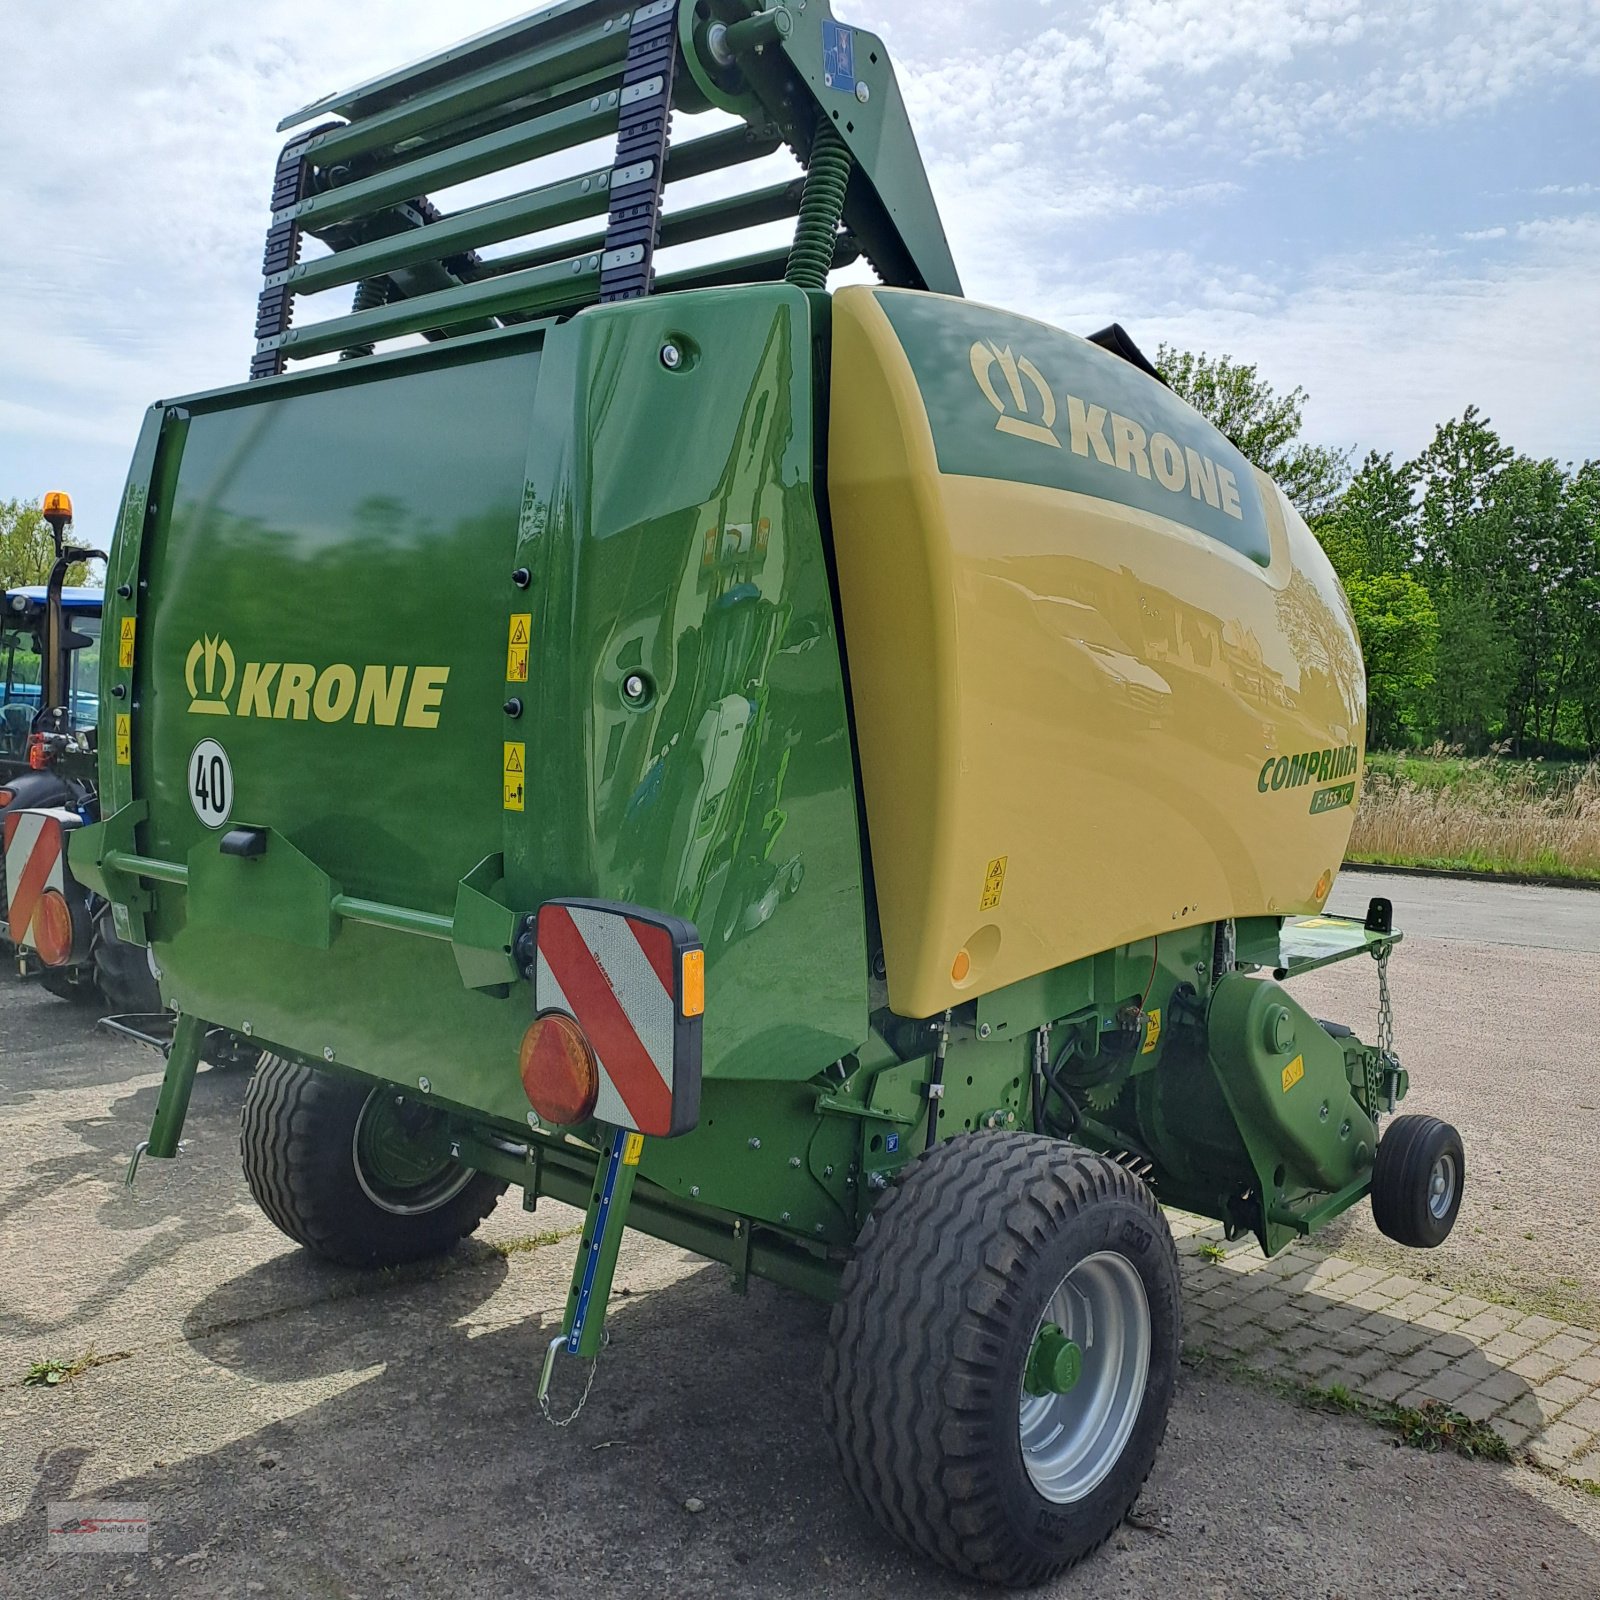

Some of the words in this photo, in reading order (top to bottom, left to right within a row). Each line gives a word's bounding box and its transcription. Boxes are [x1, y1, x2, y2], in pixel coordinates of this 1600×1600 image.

[1066, 394, 1243, 521] KRONE
[236, 662, 451, 729] KRONE
[195, 754, 226, 813] 40
[1258, 745, 1357, 793] COMPRIMA
[1315, 794, 1324, 810] F
[1324, 790, 1339, 808] 155
[1338, 786, 1351, 804] XC
[613, 1151, 619, 1159] 4
[603, 1196, 609, 1205] 5
[593, 1242, 599, 1251] 6
